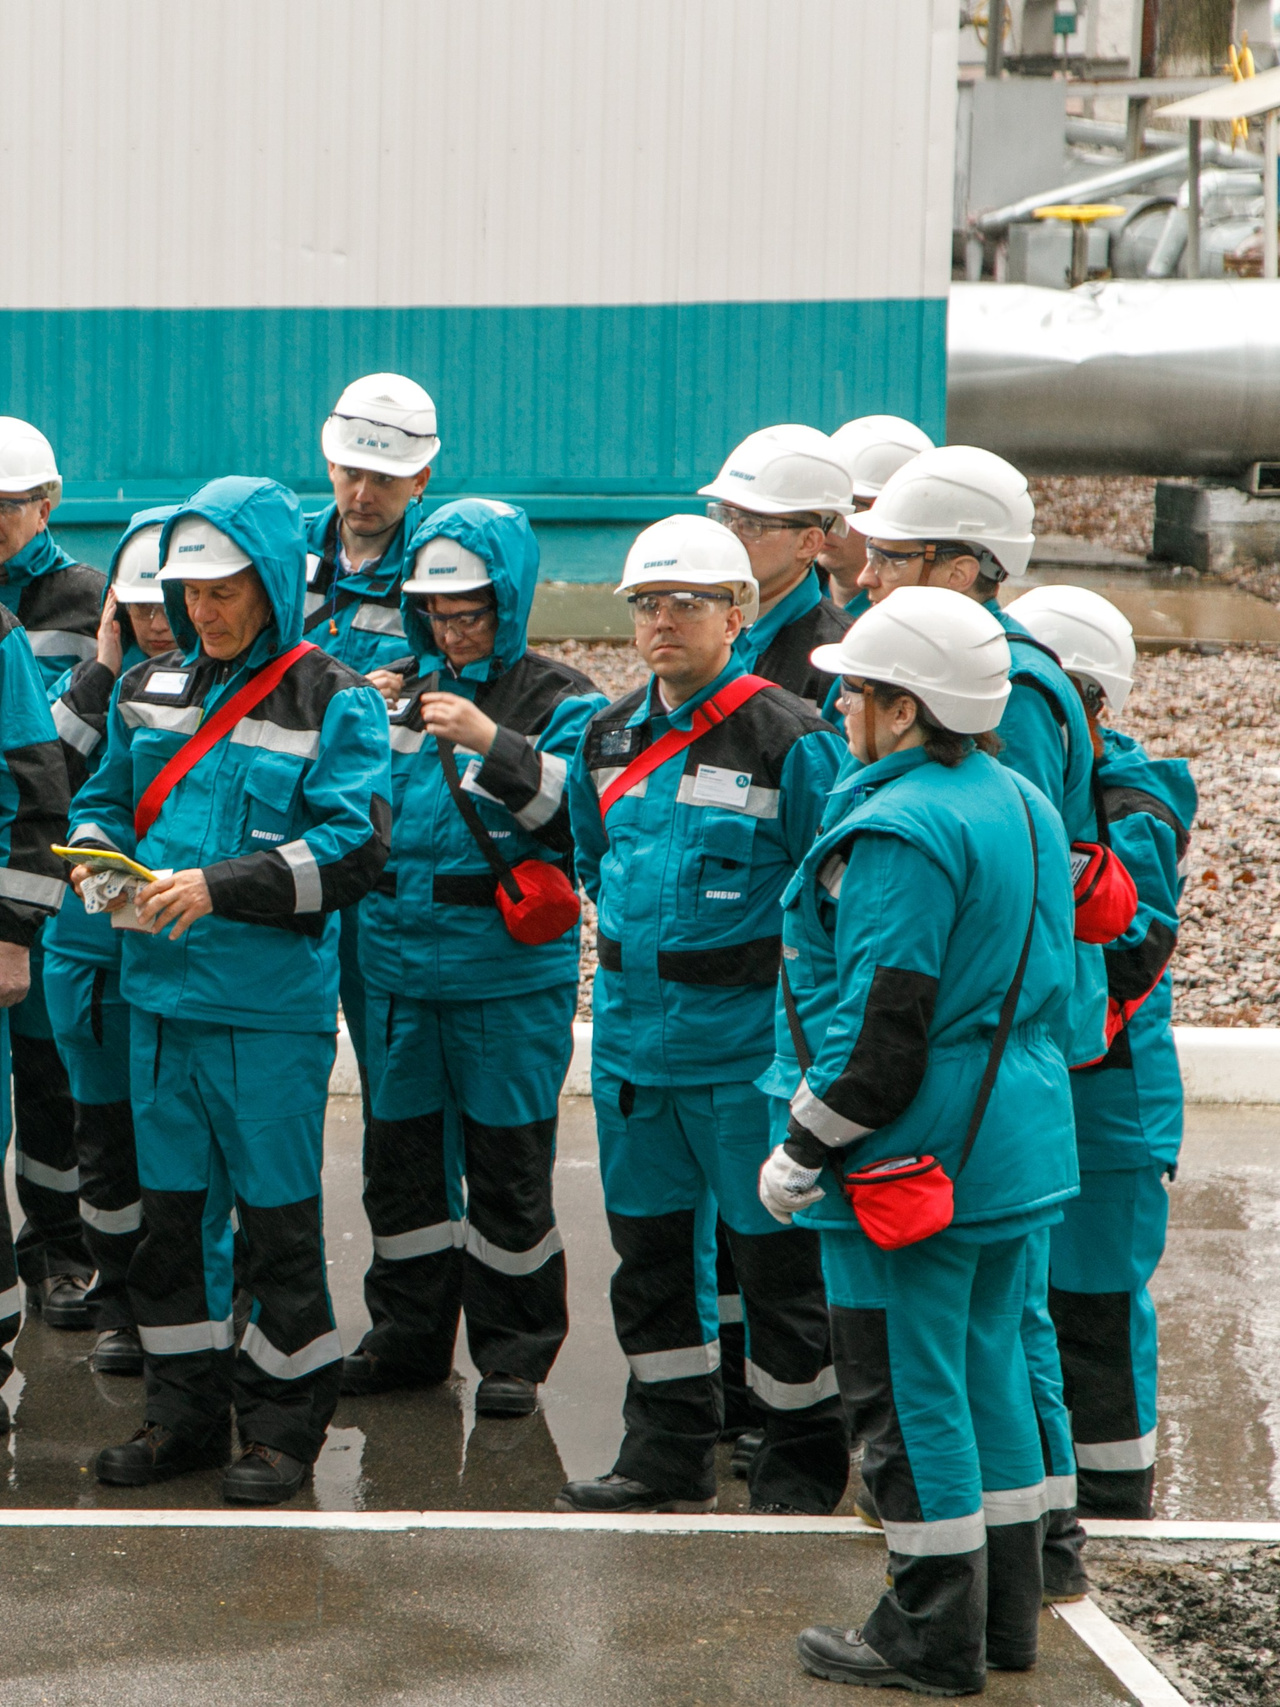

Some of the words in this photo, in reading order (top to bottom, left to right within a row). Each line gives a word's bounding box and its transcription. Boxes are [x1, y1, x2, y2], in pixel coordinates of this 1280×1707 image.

[644, 559, 678, 569] СИБУР
[428, 566, 457, 575] СИБУР
[251, 829, 285, 842] СИБУР
[705, 890, 741, 900] СИБУР
